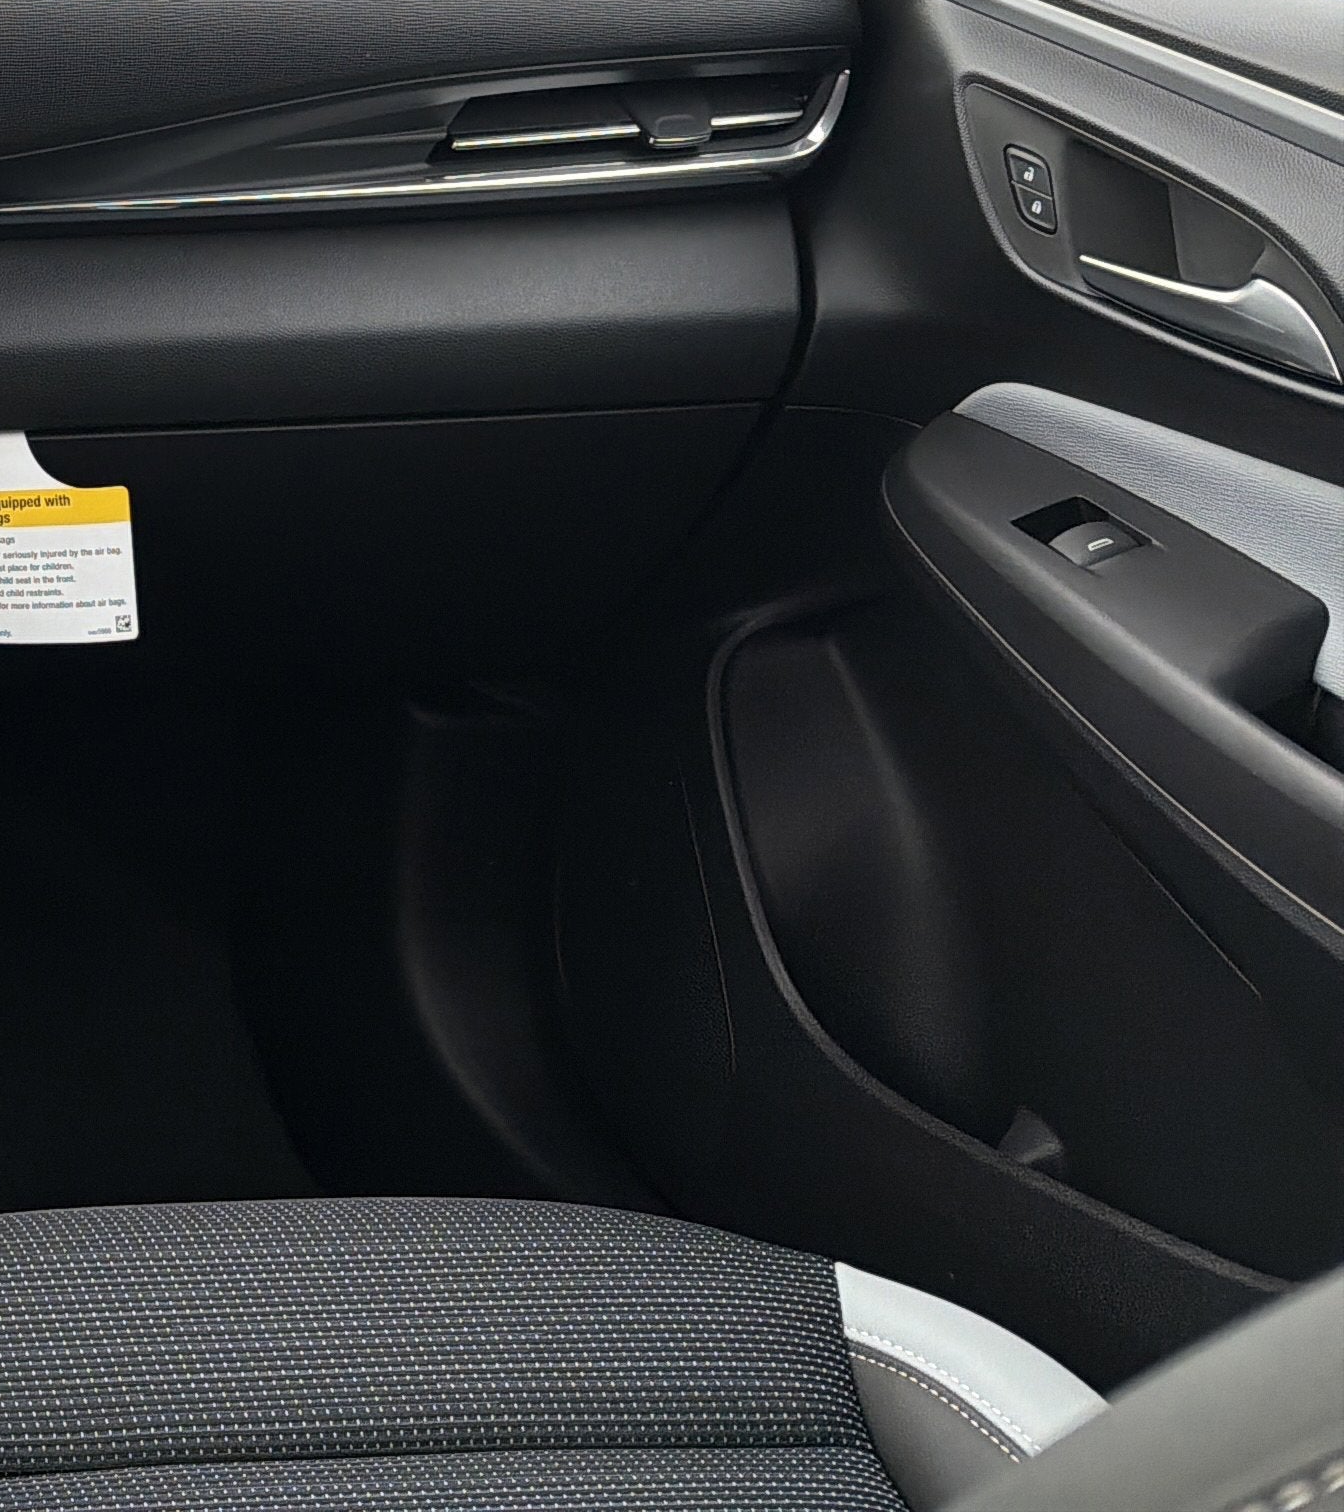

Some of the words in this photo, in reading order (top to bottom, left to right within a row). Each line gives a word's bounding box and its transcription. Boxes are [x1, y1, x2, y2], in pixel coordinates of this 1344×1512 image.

[44, 493, 71, 508] with
[2, 550, 38, 560] seriously
[40, 549, 68, 559] injured
[69, 549, 79, 558] by
[80, 548, 93, 556] the
[106, 547, 123, 556] bag.
[7, 564, 28, 573] place
[29, 563, 40, 571] for
[41, 562, 75, 571] children.
[15, 577, 32, 585] seat
[33, 576, 41, 584] in
[42, 576, 55, 584] the
[5, 589, 25, 597] child
[25, 588, 64, 597] restraints.
[10, 602, 30, 610] more
[31, 600, 74, 609] information
[75, 599, 96, 609] about
[97, 598, 107, 607] air
